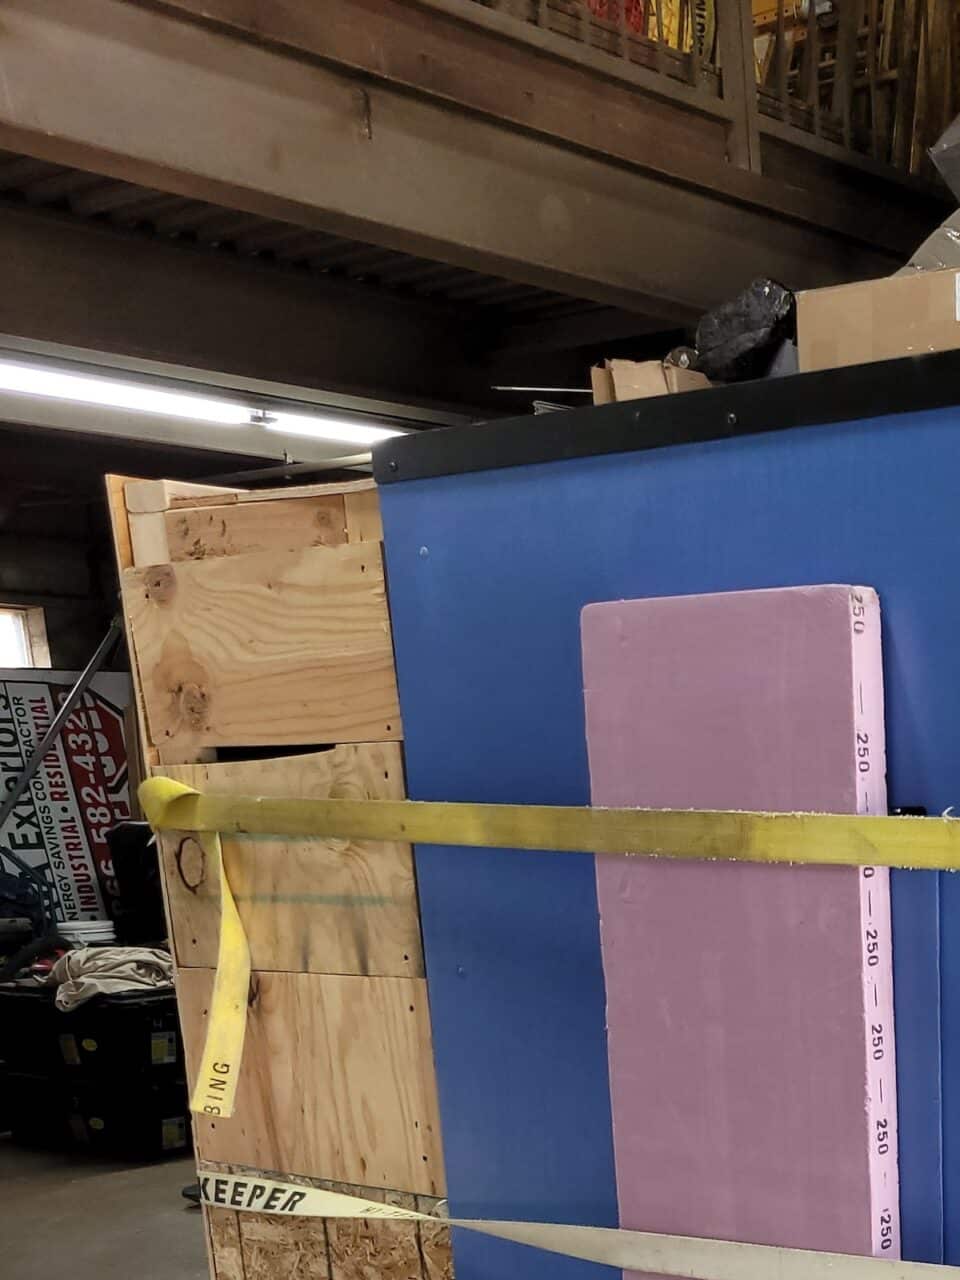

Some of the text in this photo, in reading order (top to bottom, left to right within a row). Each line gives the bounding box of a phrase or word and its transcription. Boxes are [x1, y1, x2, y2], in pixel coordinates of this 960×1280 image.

[851, 591, 865, 635] 250
[13, 696, 47, 801] CONRACTOR
[856, 732, 870, 773] 250
[40, 805, 65, 870] SAVINGS
[59, 816, 99, 912] INDUSTRIAL
[866, 929, 879, 967] 250
[871, 1023, 884, 1061] 250
[876, 1118, 889, 1156] 250
[198, 1177, 306, 1211] KEEPER
[880, 1213, 892, 1250] 250
